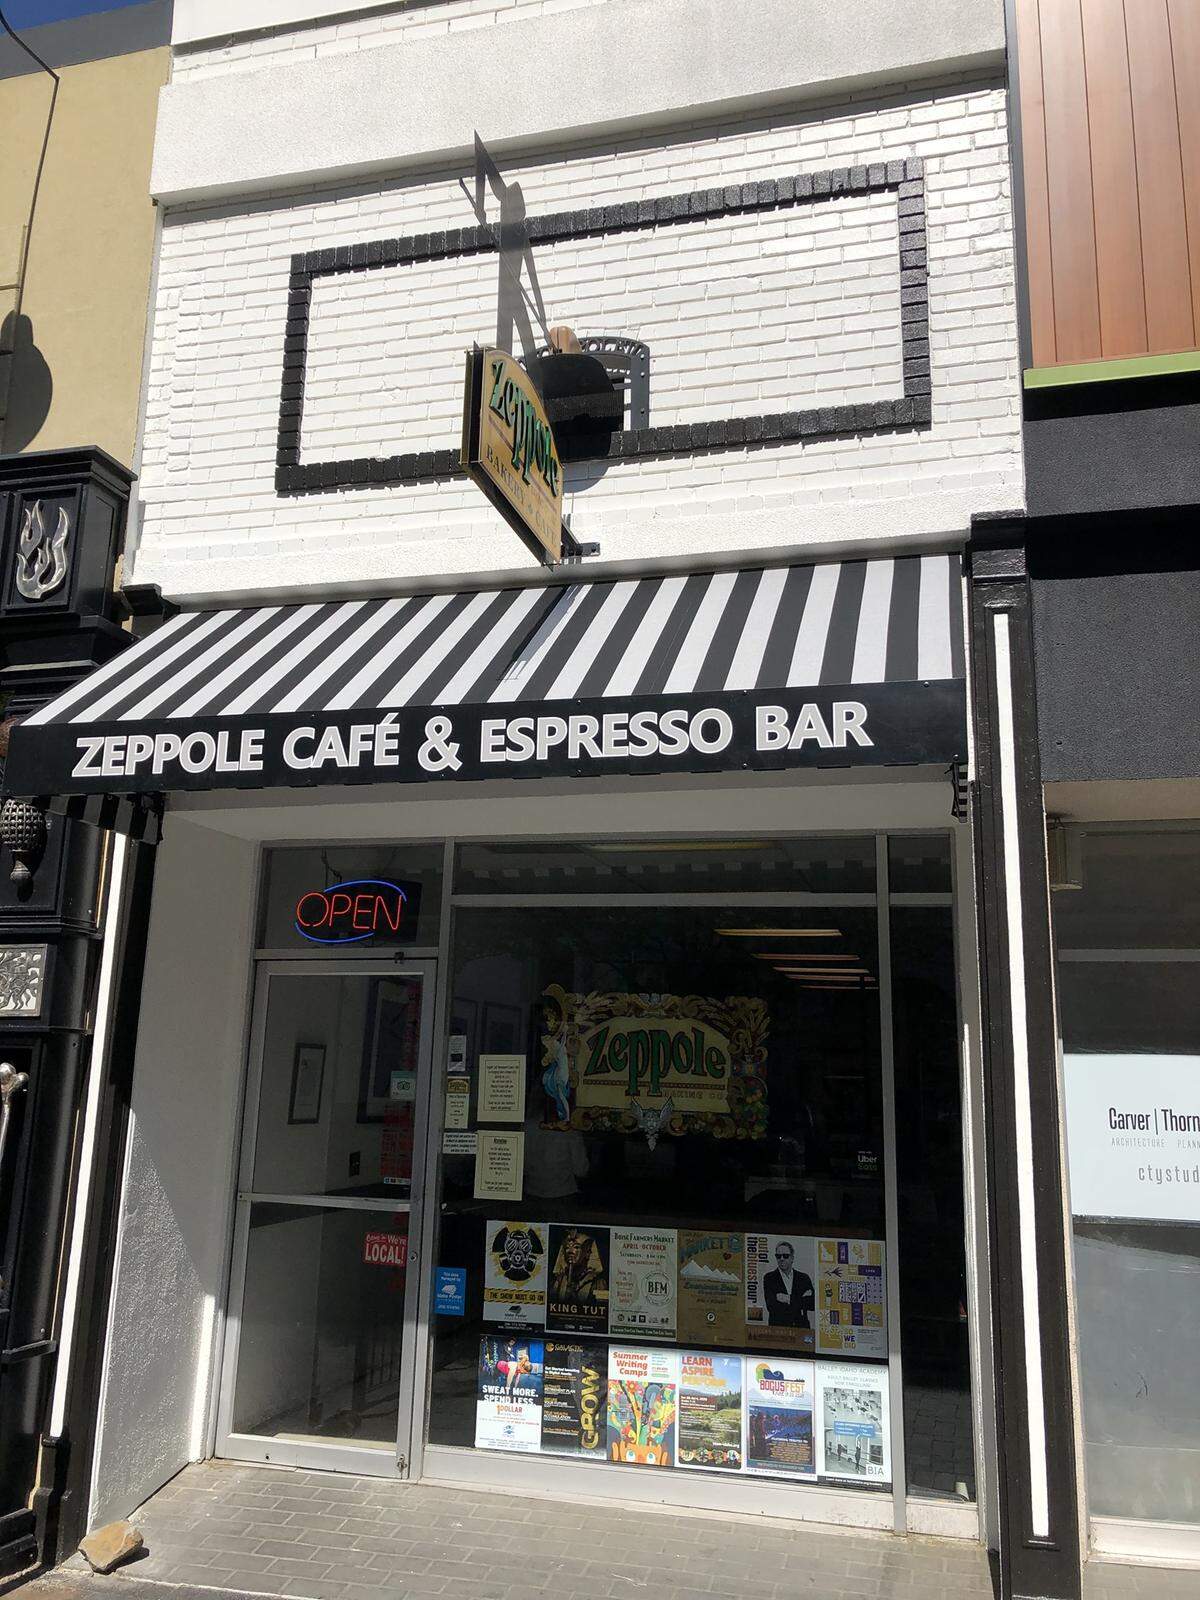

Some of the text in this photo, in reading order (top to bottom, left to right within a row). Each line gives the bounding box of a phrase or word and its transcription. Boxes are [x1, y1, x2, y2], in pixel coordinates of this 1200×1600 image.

[490, 360, 560, 498] Zeppole
[71, 701, 874, 777] ZEPPOLE CAFÉ & ESPRESSO BAR
[296, 892, 403, 931] OPEN
[584, 1026, 726, 1097] Zeppole
[1108, 1107, 1151, 1131] Carver
[1161, 1108, 1200, 1132] Thorn
[1111, 1137, 1165, 1148] ARCHITECTURE
[1138, 1164, 1200, 1185] ctystud
[365, 1243, 405, 1264] LOCAL!
[648, 1281, 668, 1294] BFM
[550, 1303, 606, 1316] KING TUT
[613, 1351, 648, 1361] Summer
[682, 1356, 713, 1366] LEARN
[617, 1360, 648, 1371] Writing
[620, 1368, 648, 1378] Camps
[482, 1384, 539, 1398] SWEAT MORE.
[581, 1365, 600, 1449] GROW
[867, 1466, 884, 1475] BIA
